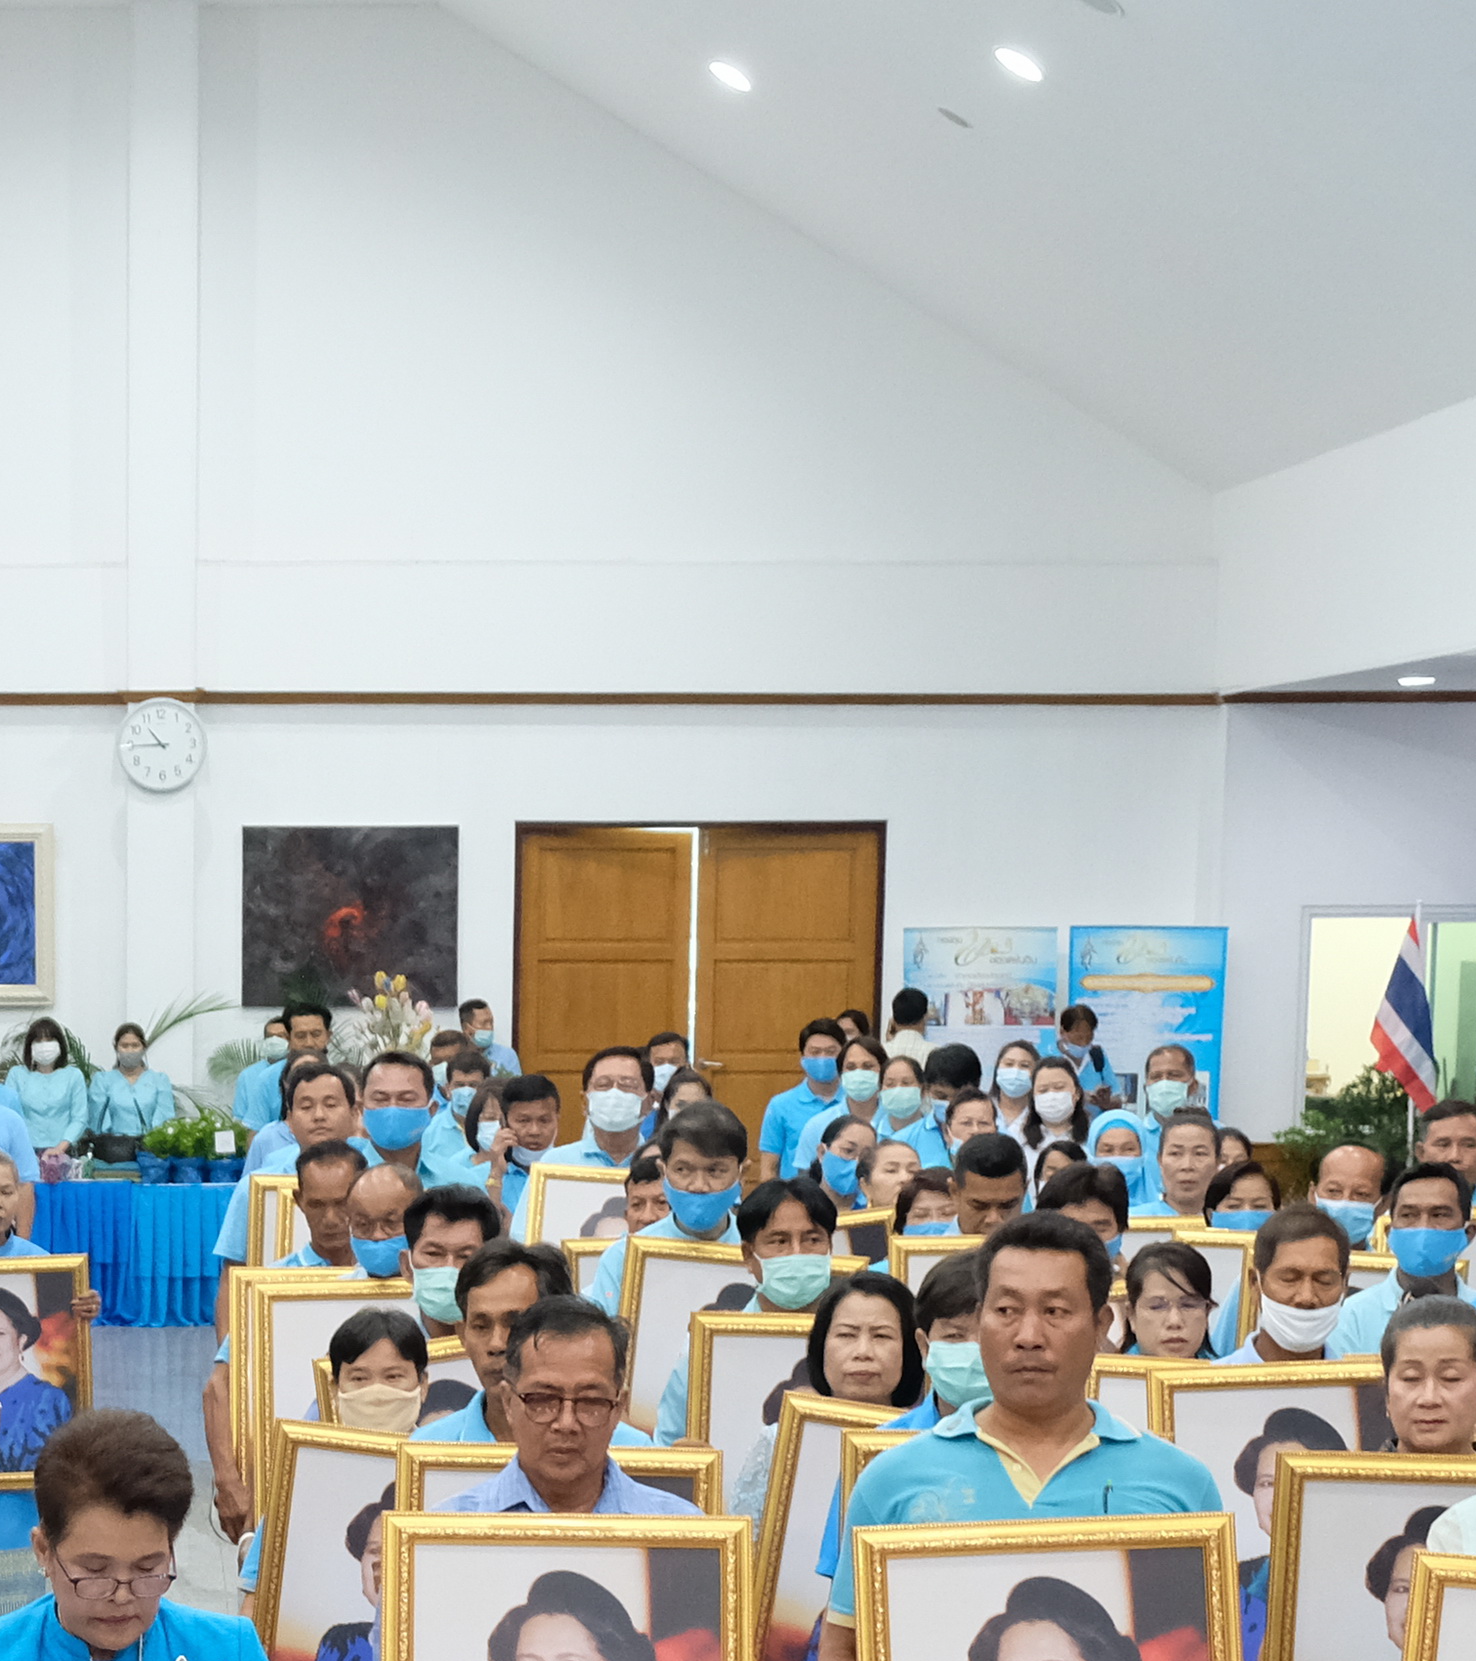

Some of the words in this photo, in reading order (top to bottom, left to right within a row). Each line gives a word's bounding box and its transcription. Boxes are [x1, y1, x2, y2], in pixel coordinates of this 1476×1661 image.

[142, 713, 151, 724] 11
[156, 708, 166, 720] 12
[130, 724, 142, 735] 10
[185, 722, 192, 734] 2
[189, 737, 197, 749] 3
[132, 754, 140, 766] 8
[185, 753, 193, 764] 4
[144, 766, 151, 777] 7
[158, 769, 166, 781] 6
[174, 765, 182, 777] 5
